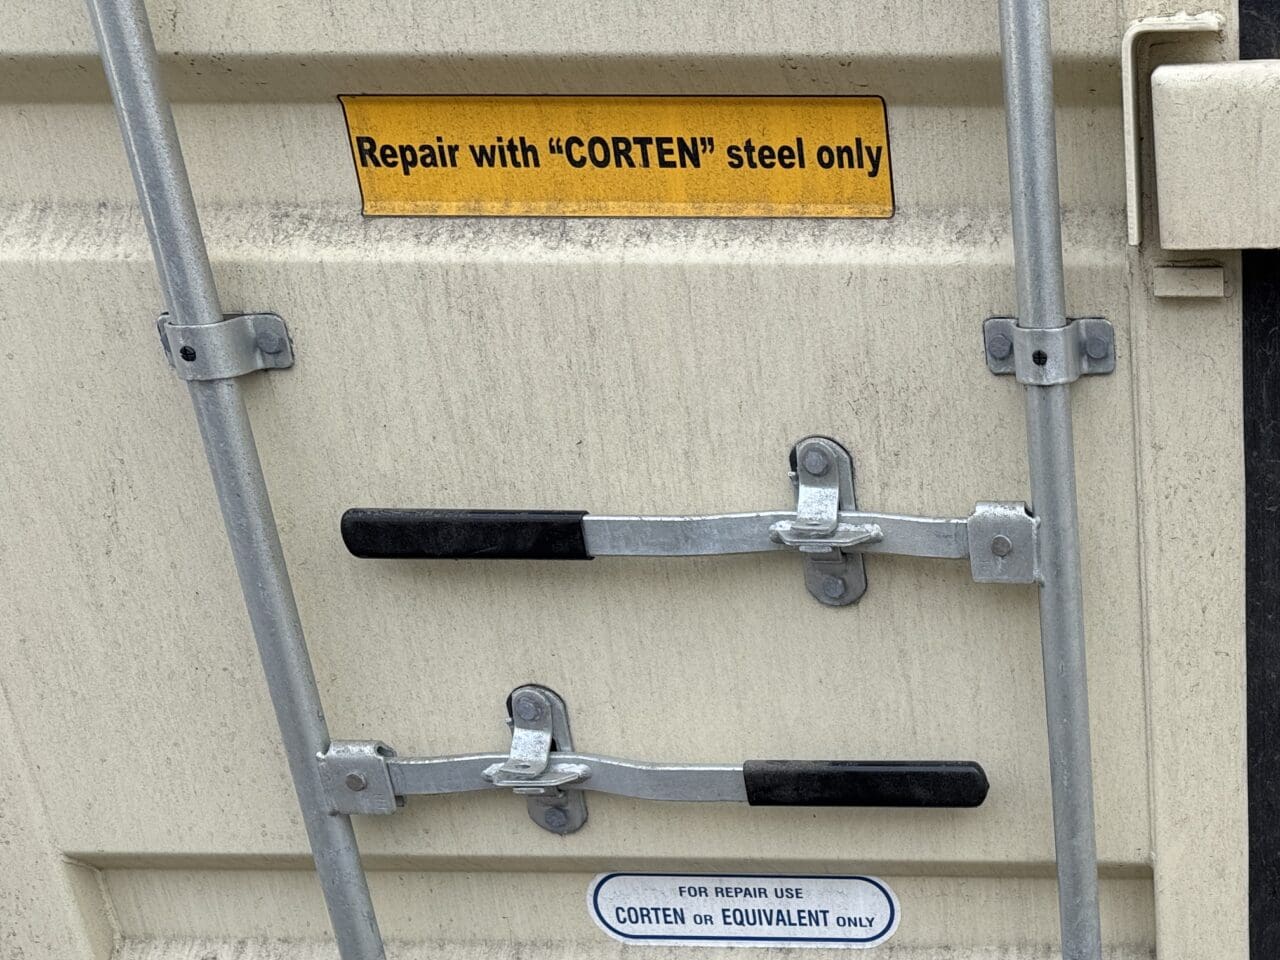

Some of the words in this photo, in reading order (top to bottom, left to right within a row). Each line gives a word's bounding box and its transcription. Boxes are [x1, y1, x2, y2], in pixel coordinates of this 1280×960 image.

[356, 136, 459, 175] Repair
[470, 136, 541, 168] with
[549, 136, 715, 168] “CORTEN”
[726, 138, 803, 169] steel
[816, 138, 883, 177] only
[678, 886, 709, 898] FOR
[715, 887, 769, 899] REPAIR
[774, 888, 804, 899] USE
[615, 906, 686, 925] CORTEN
[693, 914, 714, 926] OR
[722, 908, 830, 928] EQUIVALENT
[836, 916, 875, 928] ONLY
